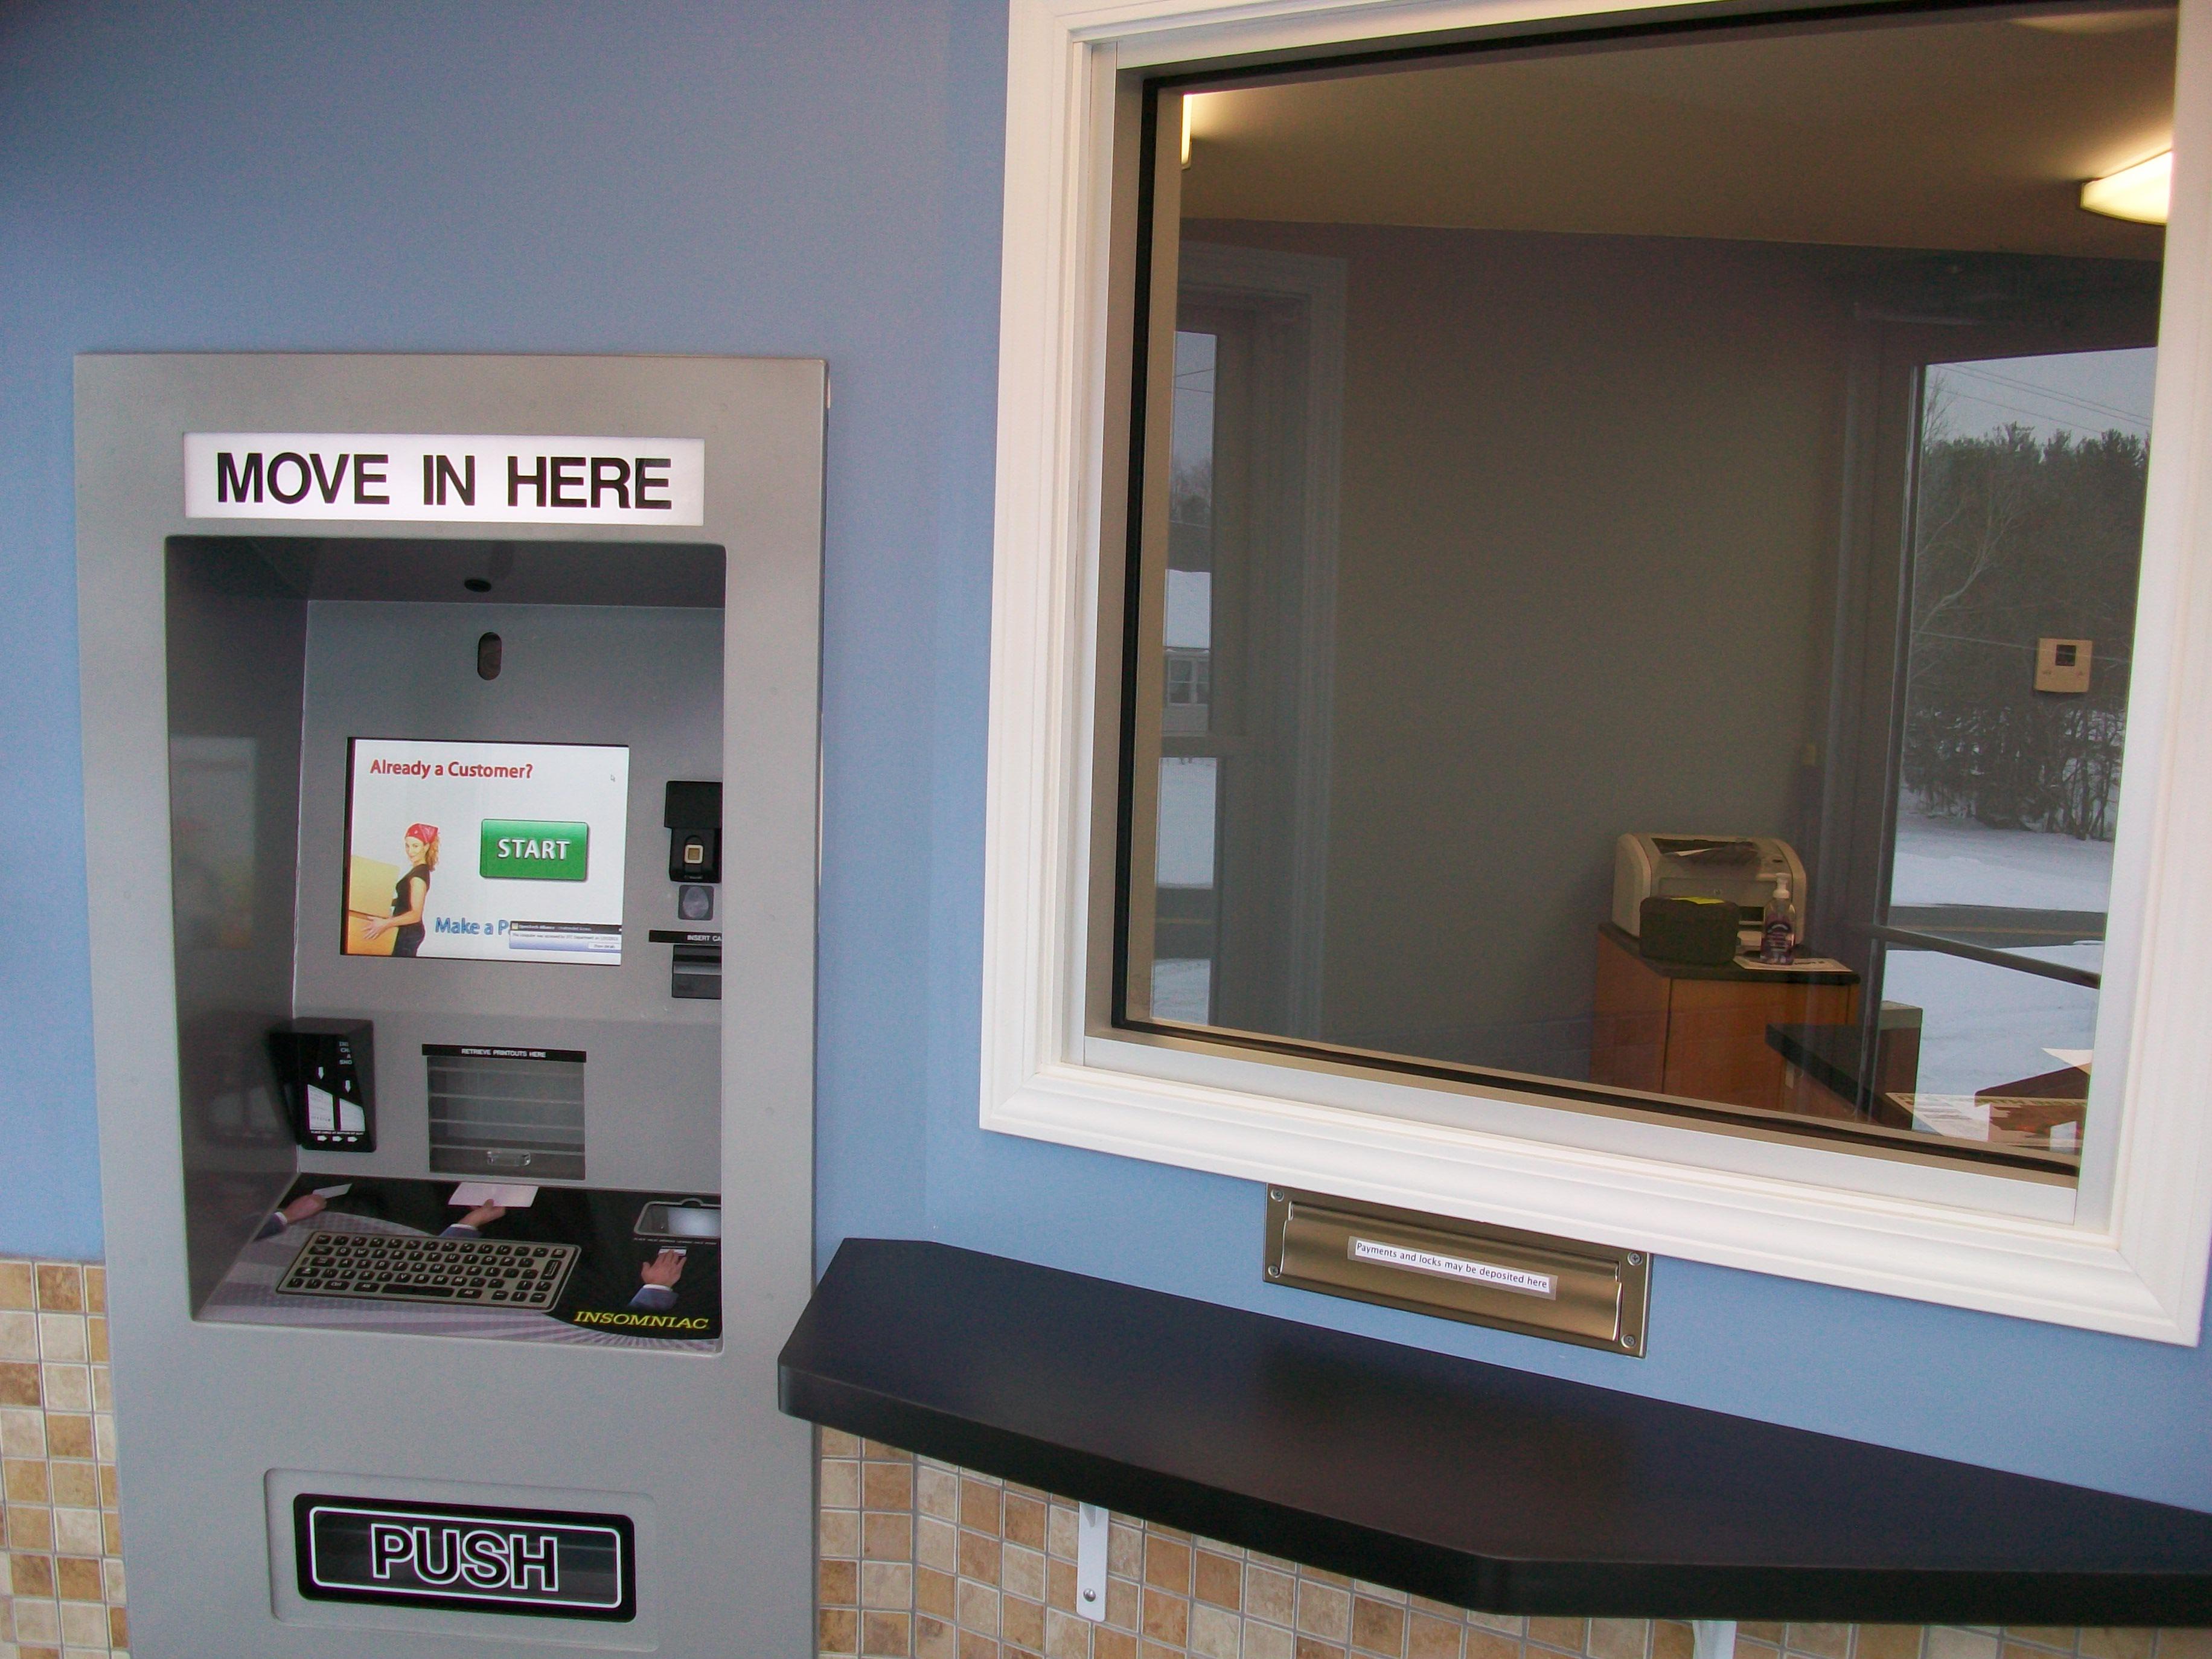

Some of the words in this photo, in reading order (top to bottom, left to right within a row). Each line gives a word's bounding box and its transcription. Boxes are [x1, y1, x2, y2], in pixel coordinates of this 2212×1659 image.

[217, 452, 389, 504] MOVE
[423, 455, 475, 505] IN
[508, 456, 671, 509] HERE
[370, 759, 430, 779] Already
[435, 765, 443, 775] a
[449, 762, 532, 778] Customer?
[498, 839, 570, 860] START
[435, 917, 480, 935] Make
[484, 923, 493, 935] a
[498, 920, 509, 935] P
[1357, 1242, 1396, 1258] Payments
[1400, 1251, 1417, 1261] and
[1419, 1255, 1441, 1267] locks
[1445, 1261, 1463, 1272] may
[1466, 1264, 1476, 1273] be
[1480, 1267, 1524, 1283] deposited
[1527, 1276, 1547, 1288] here
[574, 1311, 709, 1329] INSOMNIAC
[371, 1523, 559, 1592] PUSH
